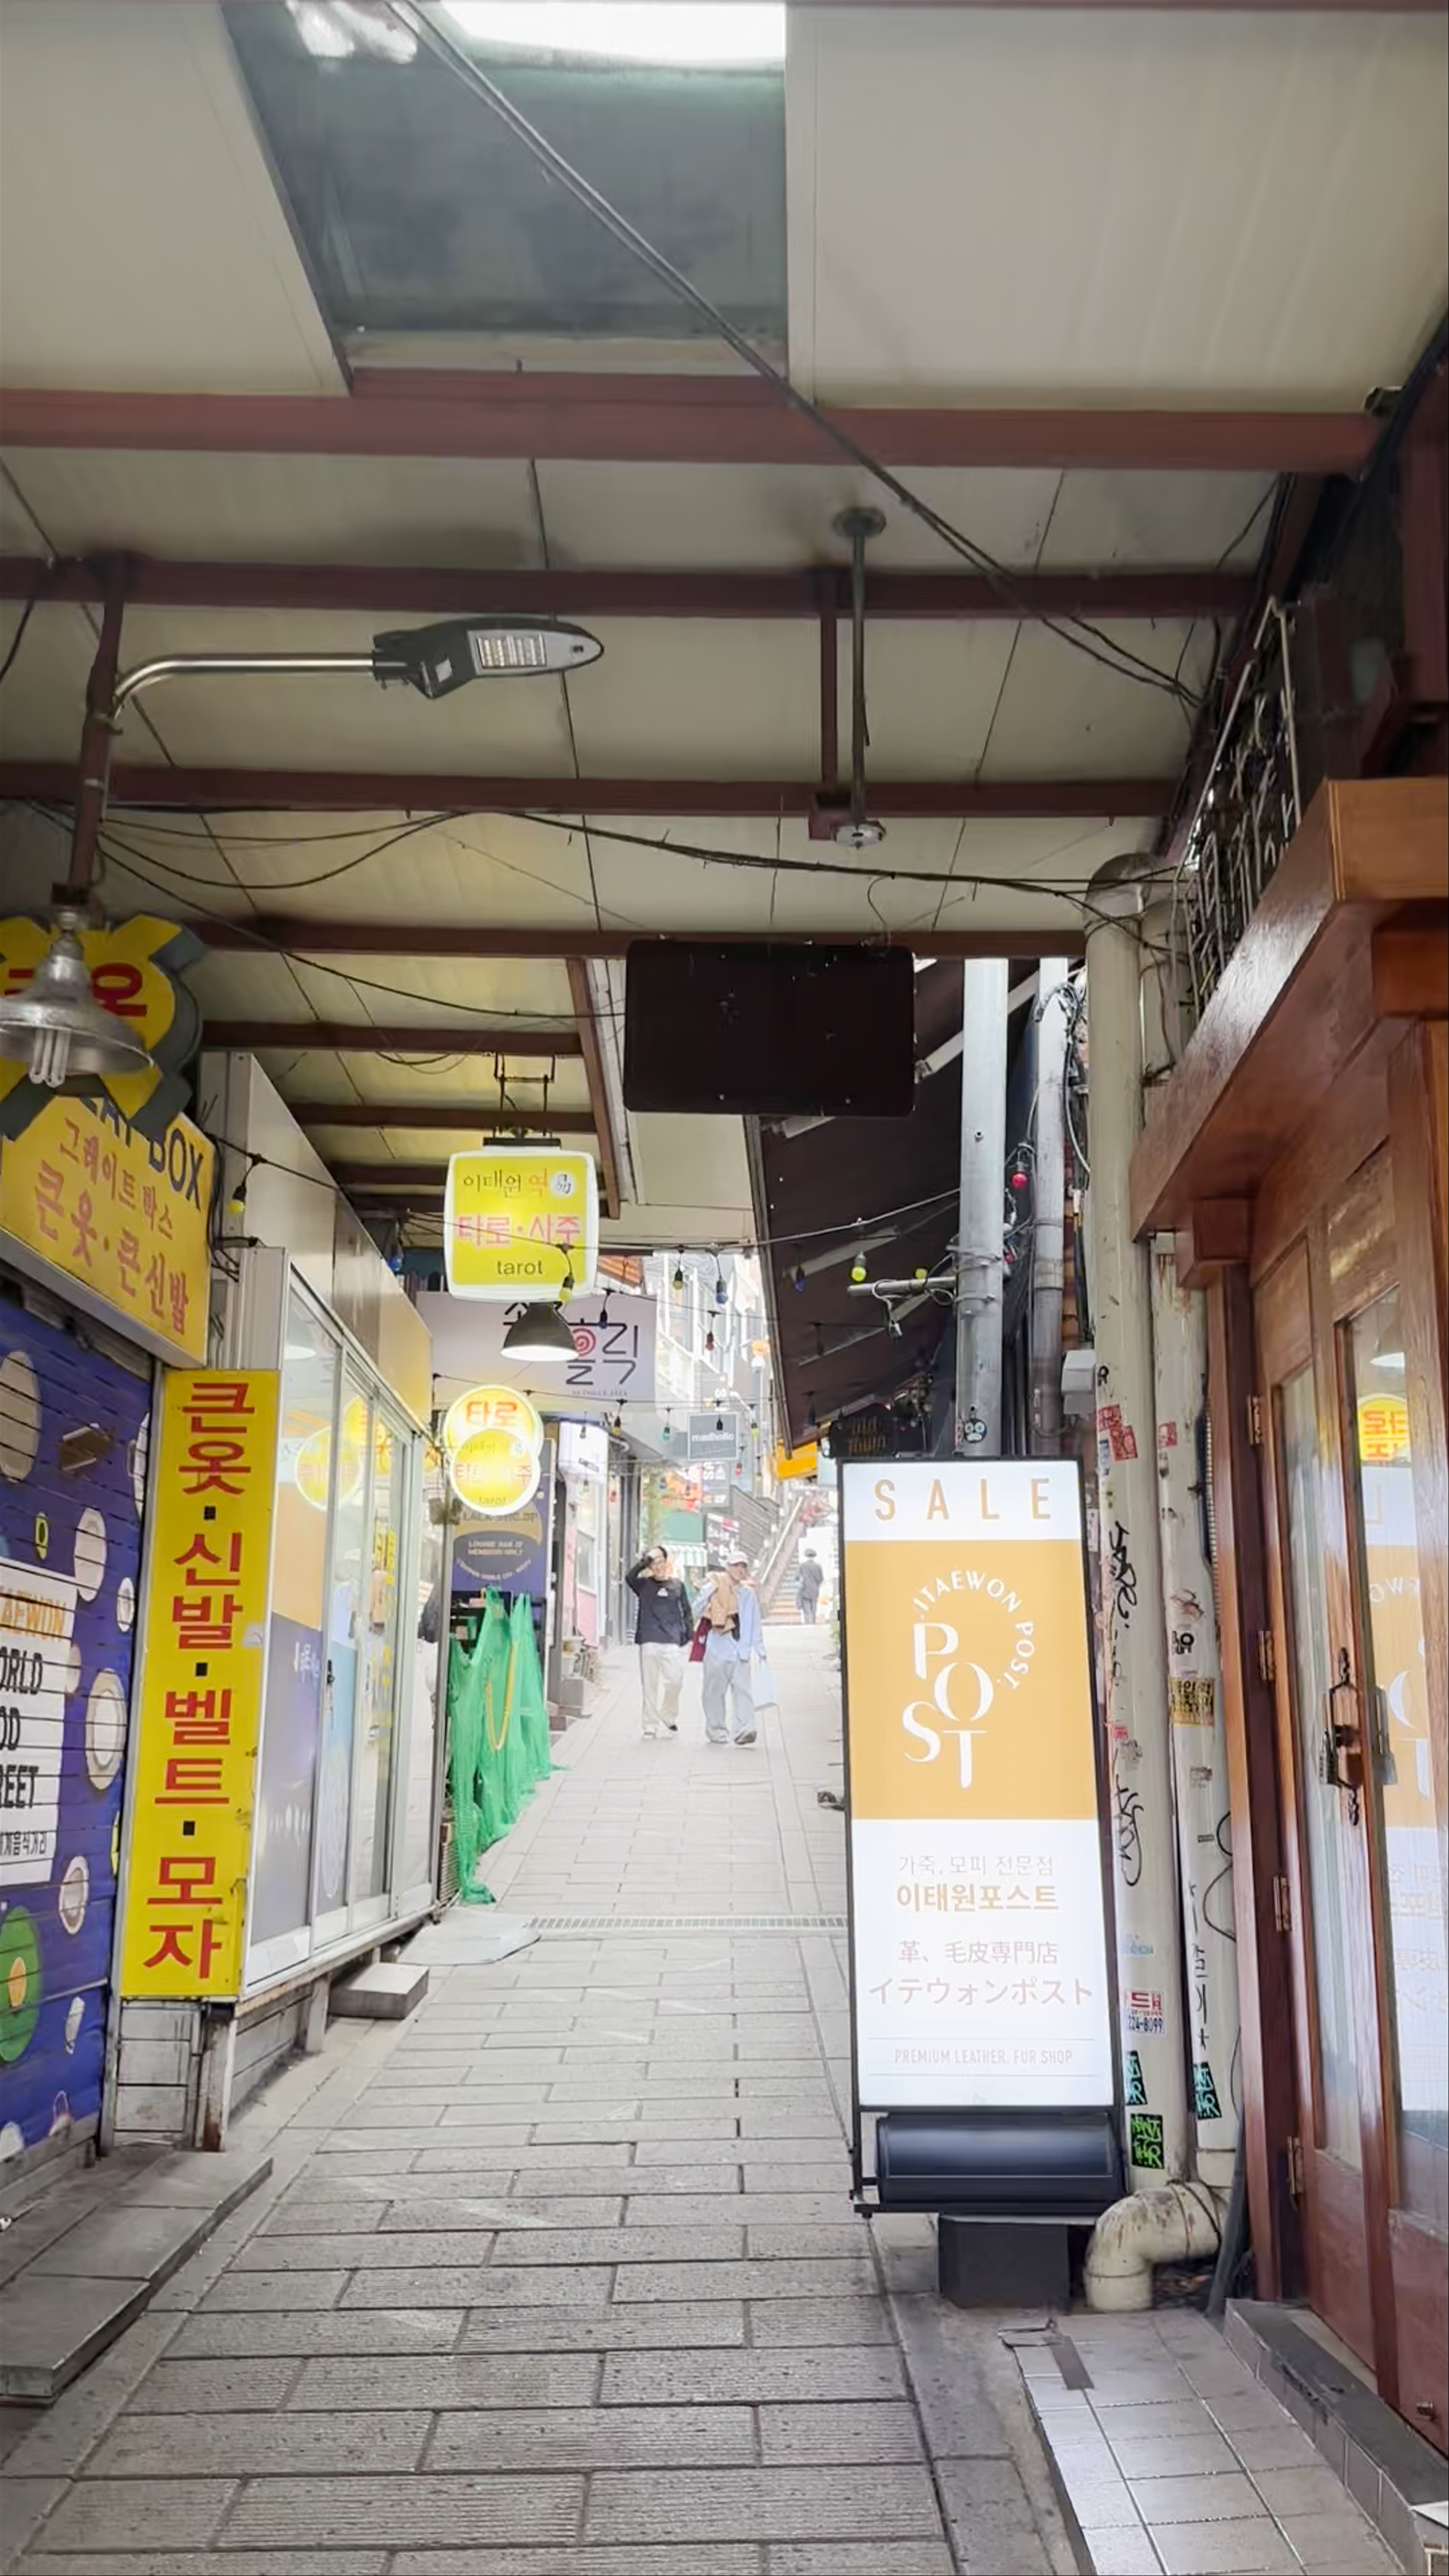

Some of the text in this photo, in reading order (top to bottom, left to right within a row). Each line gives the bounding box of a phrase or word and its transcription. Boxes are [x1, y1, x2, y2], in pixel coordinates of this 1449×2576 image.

[463, 1169, 521, 1198] 이태원
[497, 1261, 543, 1275] tarot
[466, 1401, 518, 1426] 타로
[874, 1478, 1051, 1521] SALE
[911, 1570, 1035, 1690] ITAEWON POST
[0, 1647, 43, 1695] ORLD
[949, 1856, 987, 1874] 모피
[995, 1855, 1054, 1876] 전문점
[897, 1883, 1059, 1912] 이태원포스트
[869, 1976, 1093, 2006] イテウォンポスト
[895, 2049, 950, 2064] PREMIUM
[1014, 2049, 1037, 2064] FUR
[1041, 2049, 1072, 2064] SHOP
